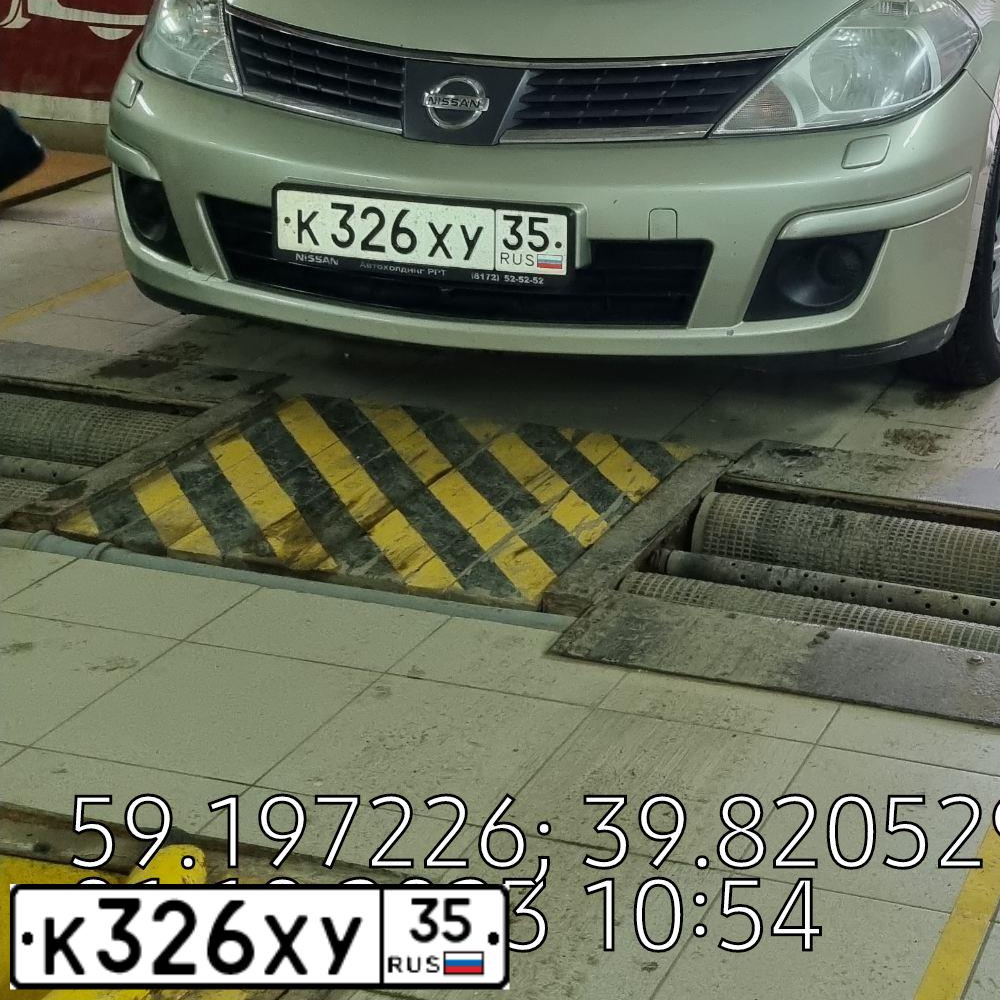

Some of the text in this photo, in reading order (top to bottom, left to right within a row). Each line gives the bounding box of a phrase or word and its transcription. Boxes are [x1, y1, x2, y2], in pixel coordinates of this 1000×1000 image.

[427, 96, 480, 109] NISSAN
[297, 202, 550, 261] К326ХУ 35
[295, 252, 339, 266] NISSAN
[500, 252, 535, 267] RUS
[471, 272, 545, 285] (8172) 52-52-52
